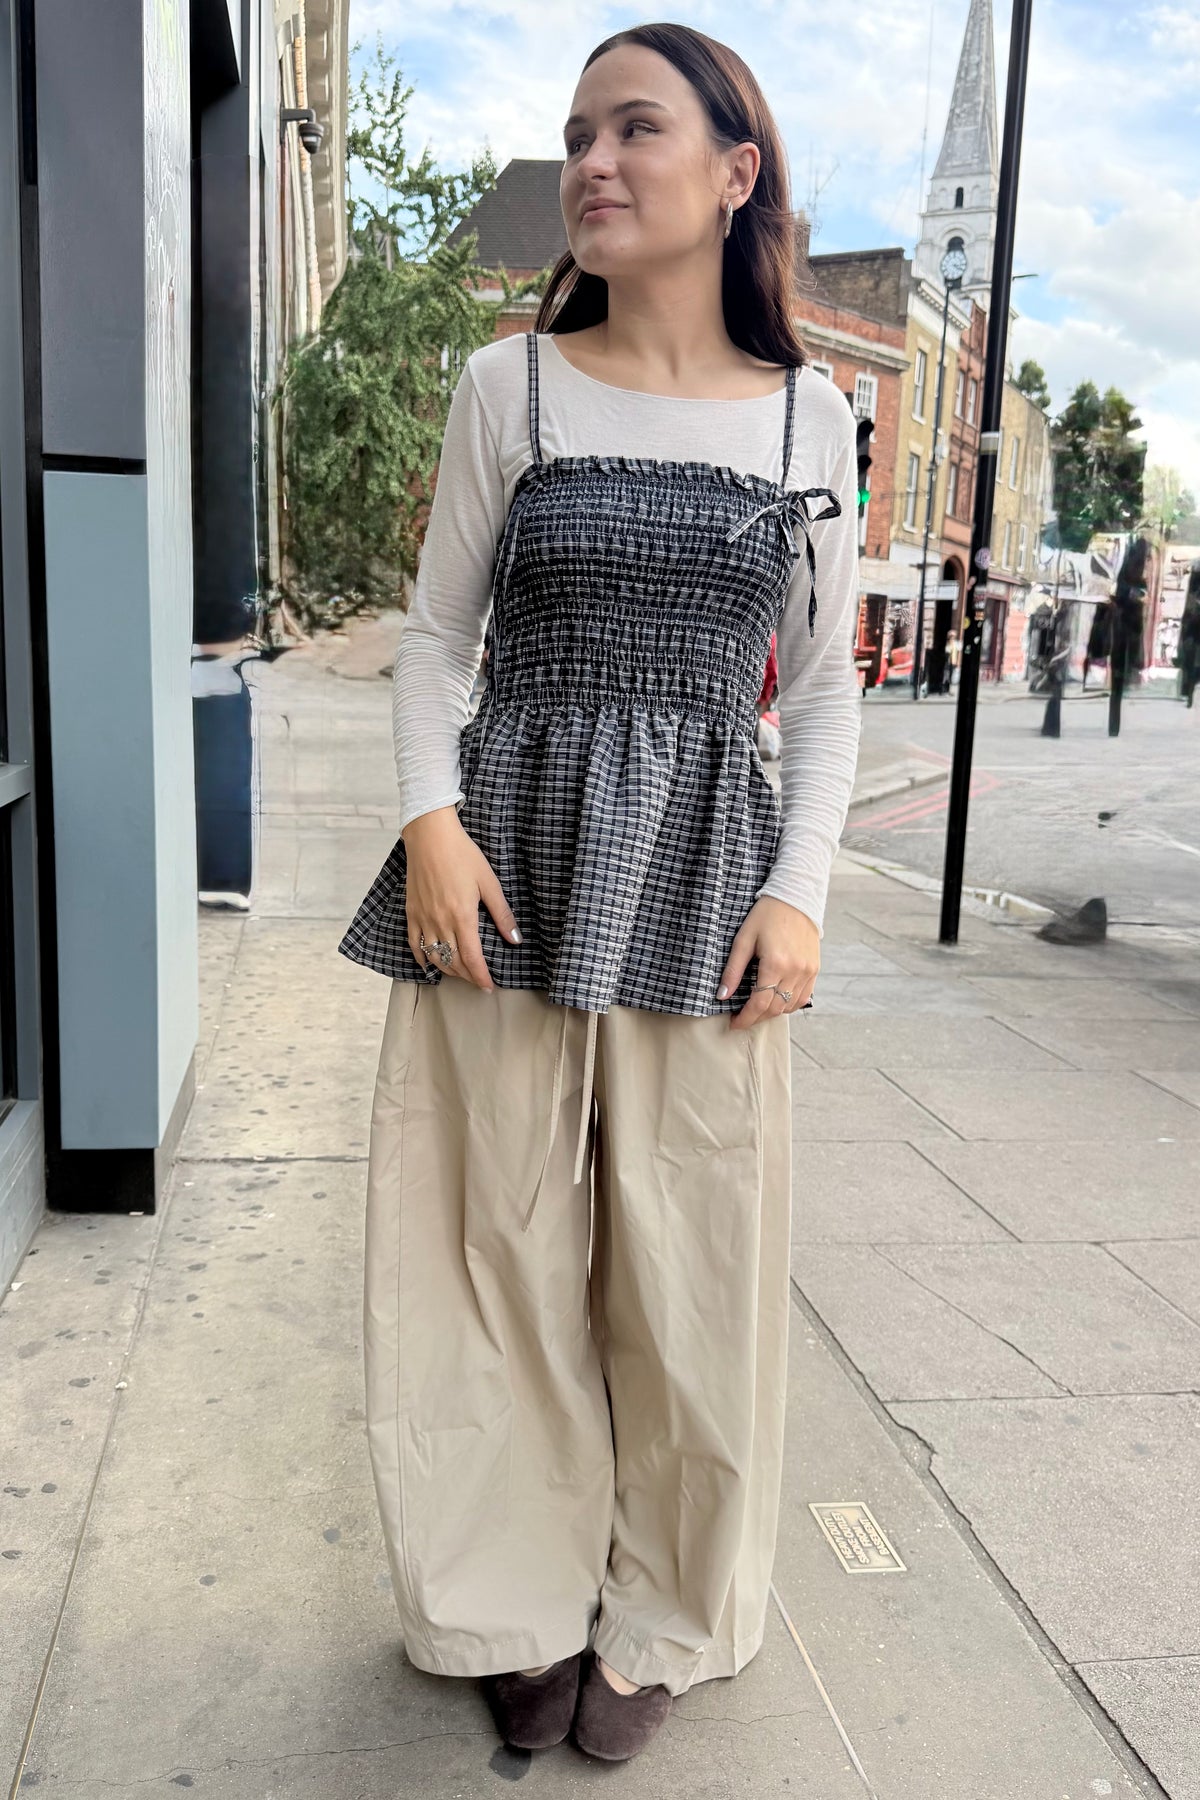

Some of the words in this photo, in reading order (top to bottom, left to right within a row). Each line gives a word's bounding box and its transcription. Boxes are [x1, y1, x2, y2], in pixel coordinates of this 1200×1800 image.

[822, 1517, 842, 1537] DUTY
[831, 1511, 855, 1538] OUTLET
[852, 1526, 873, 1547] FROM
[858, 1518, 890, 1555] BASEMENT
[833, 1535, 855, 1559] HEAVY
[846, 1537, 870, 1564] SMOKE
